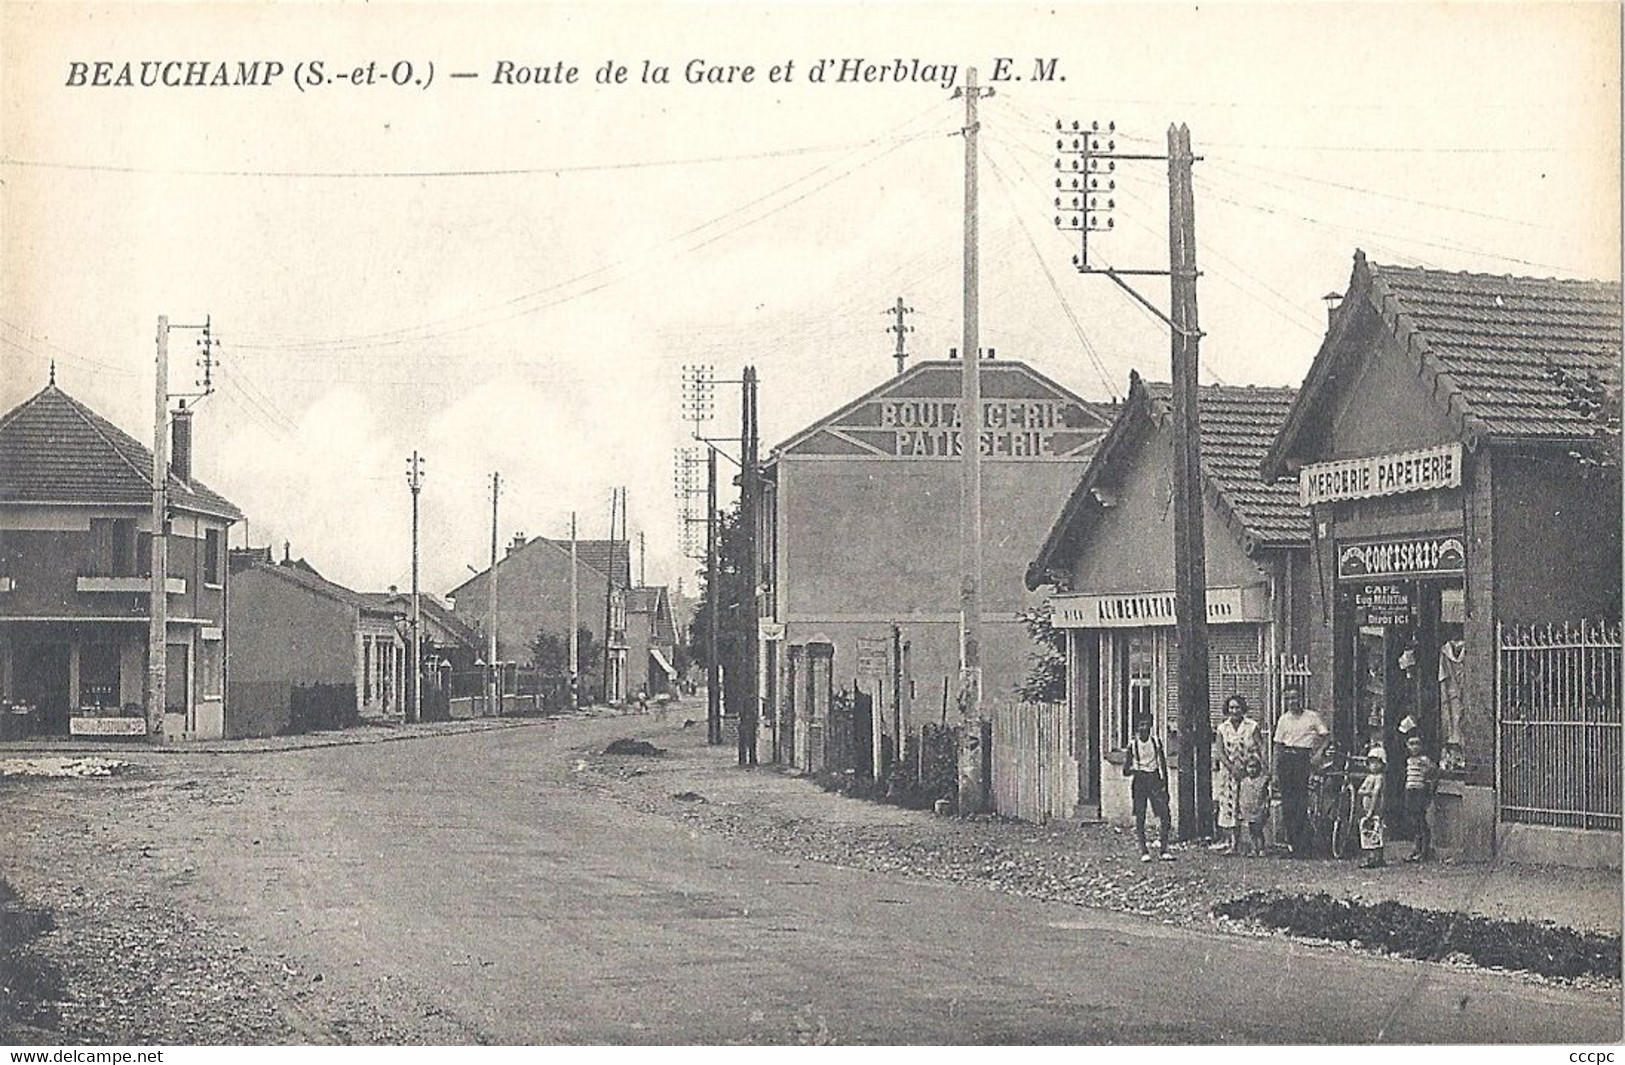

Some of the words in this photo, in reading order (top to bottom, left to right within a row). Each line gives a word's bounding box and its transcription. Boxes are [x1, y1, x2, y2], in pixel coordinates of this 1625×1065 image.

[882, 402, 1066, 428] BOULAGERIE
[1308, 468, 1370, 497] MERCERIE
[1378, 454, 1452, 491] PAPETERIE
[1365, 540, 1439, 574] CONFISERIE
[1099, 597, 1177, 620] ALIMENTATIO
